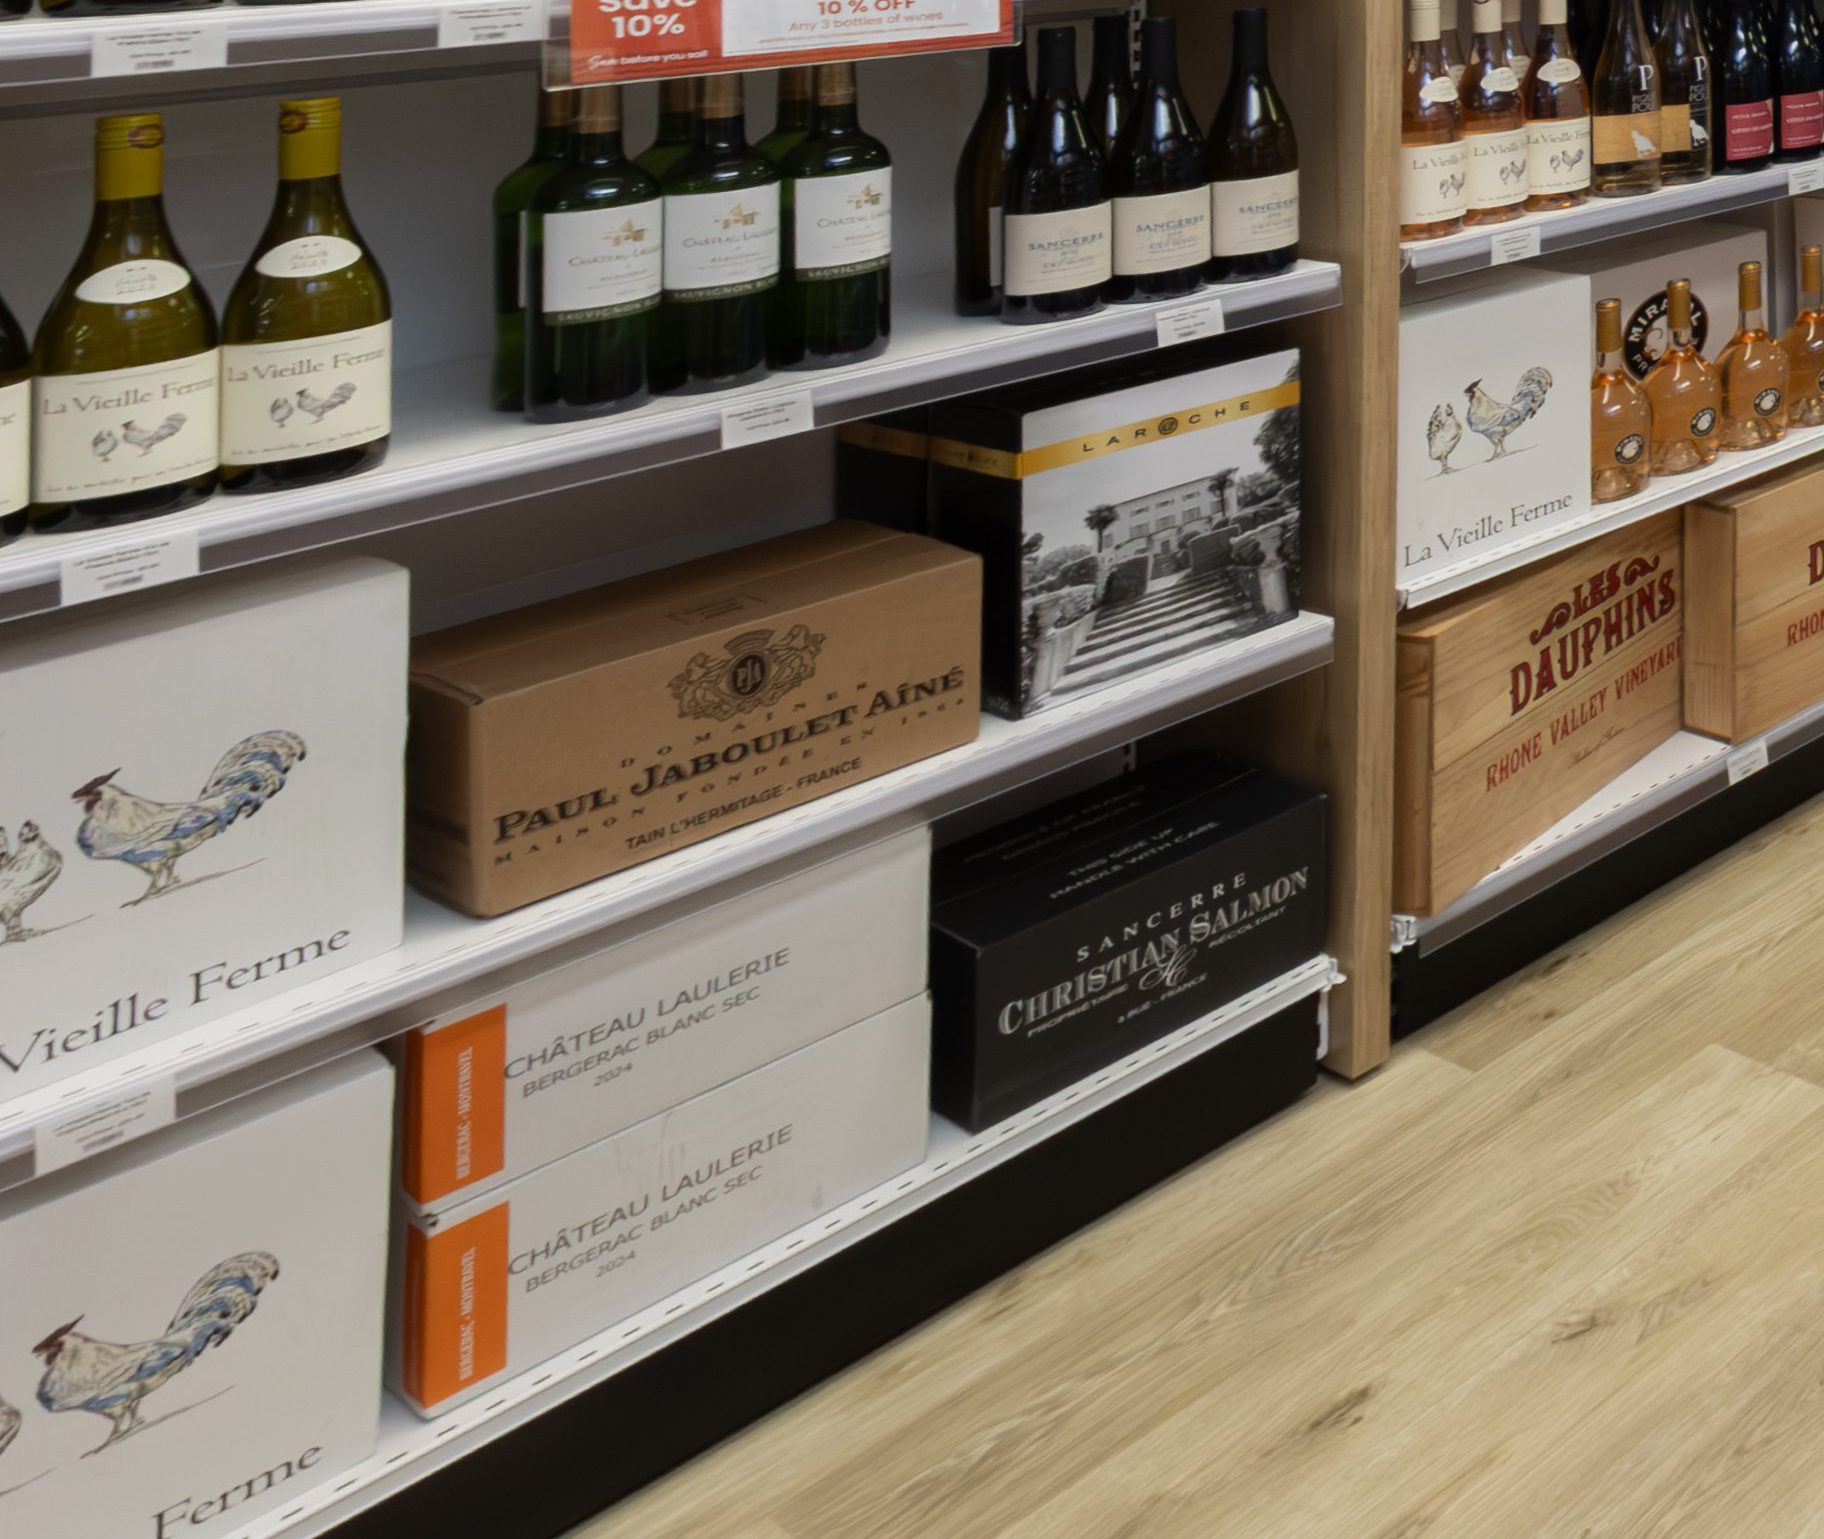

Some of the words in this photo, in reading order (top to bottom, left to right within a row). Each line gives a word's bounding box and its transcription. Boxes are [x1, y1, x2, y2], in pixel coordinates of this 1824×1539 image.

[611, 14, 686, 39] 10%
[788, 20, 814, 34] Any
[818, 0, 842, 16] 10
[848, 0, 868, 14] %
[42, 396, 69, 417] La
[71, 385, 155, 412] Vieille
[227, 364, 249, 383] La
[252, 355, 325, 381] Vieille
[1404, 545, 1432, 568] La
[1436, 517, 1503, 547] Vieille
[1511, 494, 1573, 528] Ferme
[1574, 563, 1622, 620] LES
[1509, 569, 1676, 717] DAUPHINS
[1485, 741, 1543, 793] RHONE
[1550, 688, 1607, 744] VALLEY
[1615, 634, 1684, 702] VINEYAR
[494, 787, 620, 845] PAUL
[630, 704, 859, 797] JABOULET
[625, 827, 666, 850] TAIN
[670, 784, 784, 835] L'HERMITAGE
[797, 757, 862, 790] FRANCE
[494, 806, 646, 867] MAISON
[997, 928, 1182, 1036] CHRISTIAN
[1188, 866, 1311, 945] SALMON
[1076, 872, 1248, 963] SANCERRE
[0, 995, 169, 1074] Vieille
[189, 928, 353, 1006] Ferme
[503, 1007, 647, 1080] CHÂTEAU
[656, 947, 792, 1018] LAULERIE
[522, 1036, 640, 1098] BERGERAC
[646, 1005, 718, 1044] BLANC
[720, 985, 761, 1014] SEC
[507, 1193, 650, 1276] CHÂTEAU
[660, 1123, 795, 1203] LAULERIE
[525, 1227, 645, 1294] BERGERAC
[649, 1189, 720, 1232] BLANC
[723, 1165, 764, 1195] SEC
[153, 1444, 325, 1539] Ferme
